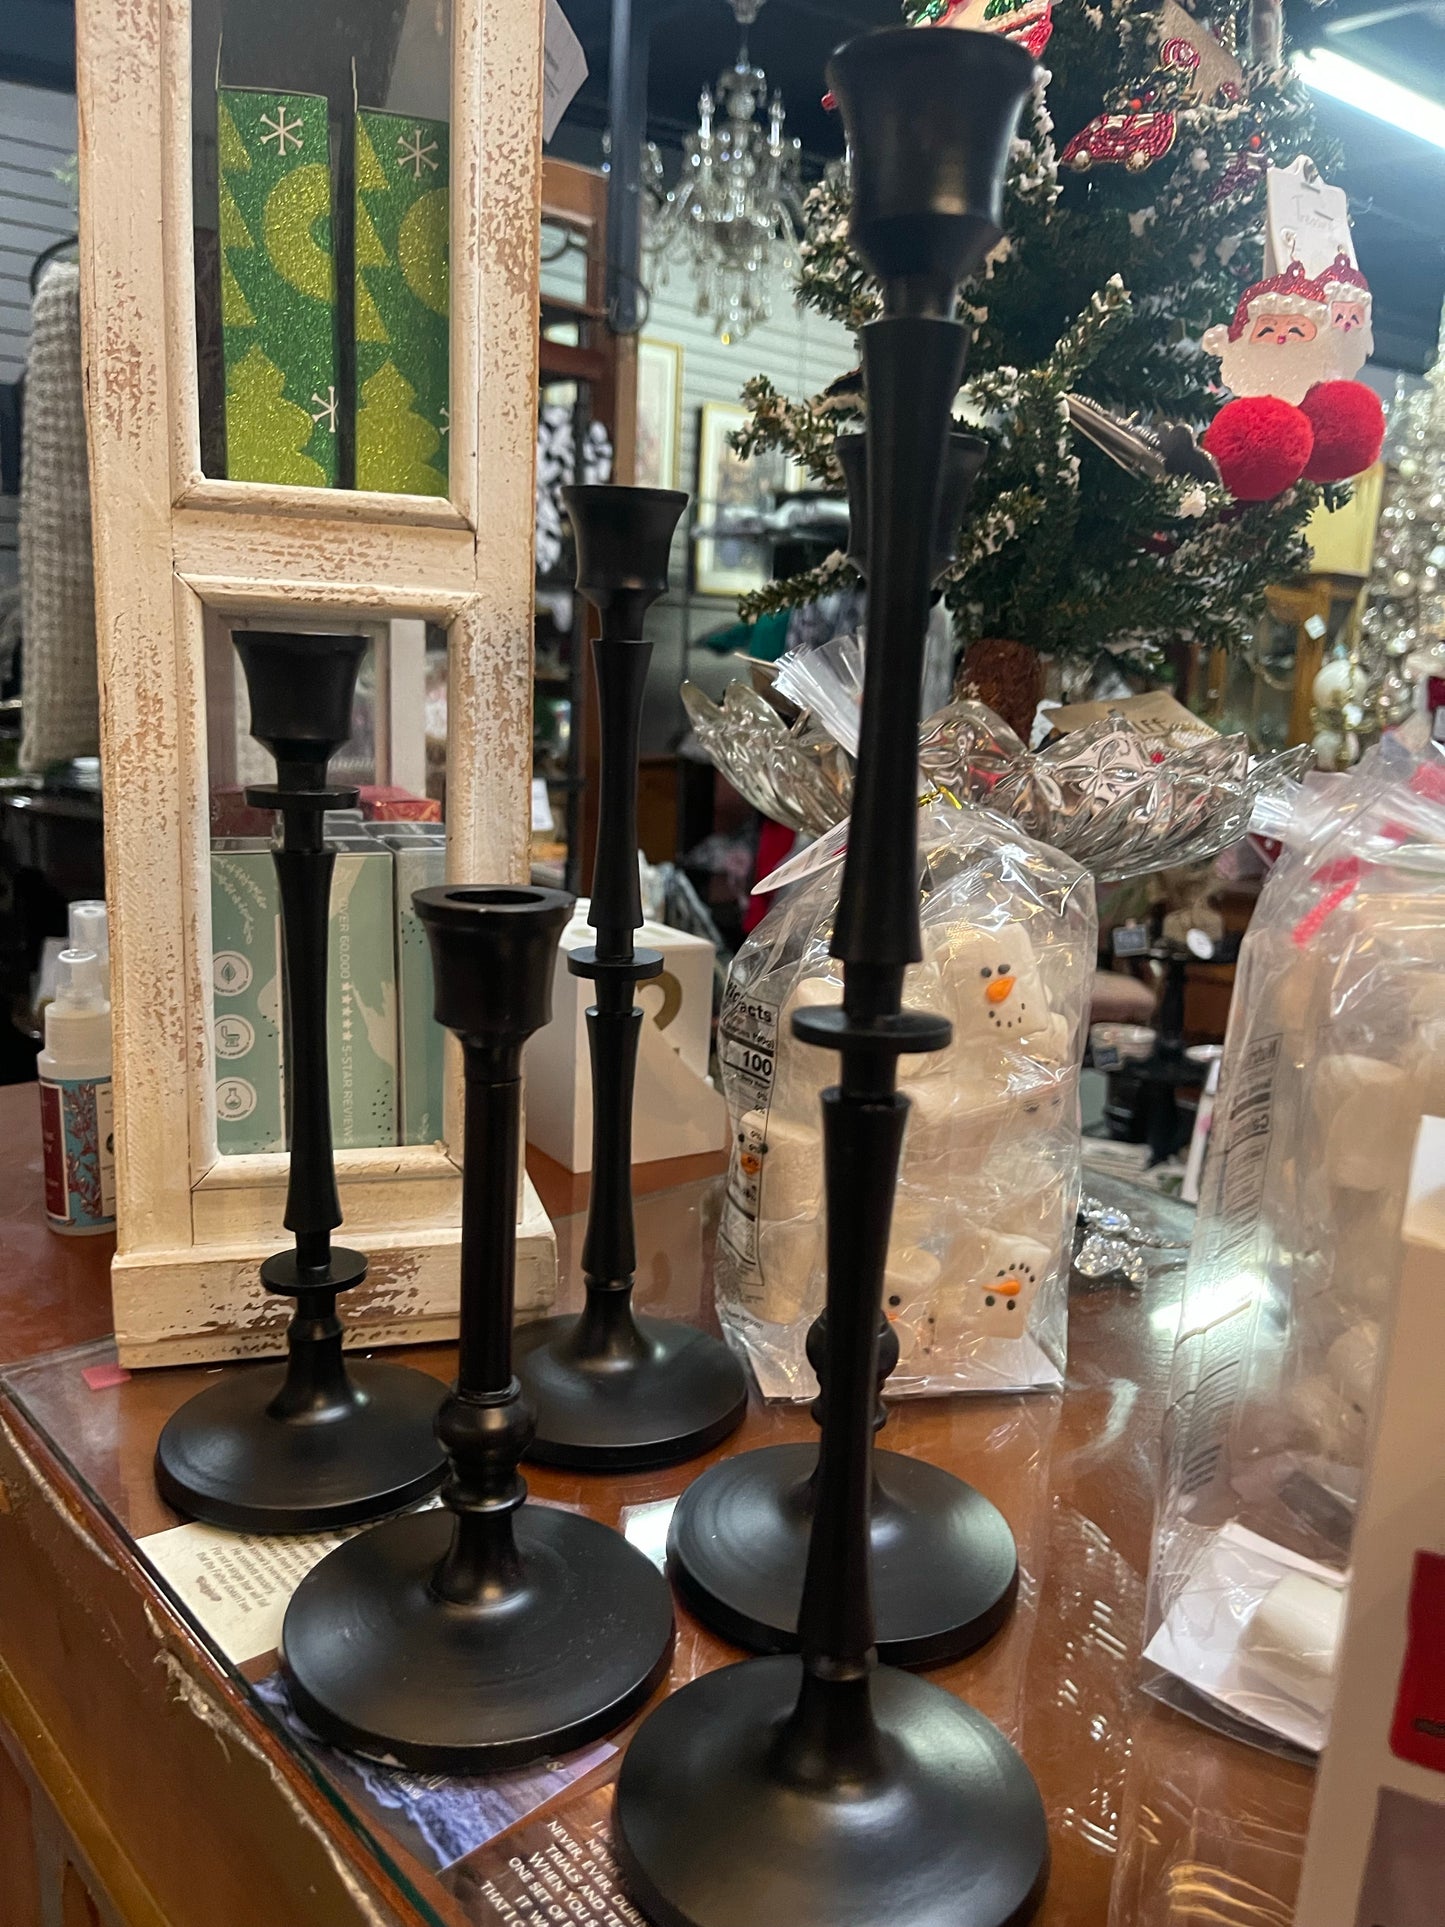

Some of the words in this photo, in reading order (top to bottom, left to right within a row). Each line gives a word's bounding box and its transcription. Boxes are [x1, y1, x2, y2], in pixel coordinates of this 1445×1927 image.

[738, 1001, 772, 1023] acts
[341, 1044, 354, 1088] 5-STAR
[742, 1049, 773, 1077] 100
[343, 1090, 354, 1145] REVIEWS
[480, 1880, 512, 1911] THAT
[508, 1856, 535, 1883] ONE
[528, 1881, 554, 1904] SET
[548, 1904, 568, 1921] OF
[529, 1851, 567, 1893] WHEN
[564, 1890, 591, 1920] YOU
[545, 1843, 584, 1883] TRIALS
[577, 1884, 607, 1911] AND
[581, 1860, 615, 1895] EVER,
[514, 1894, 534, 1909] IT
